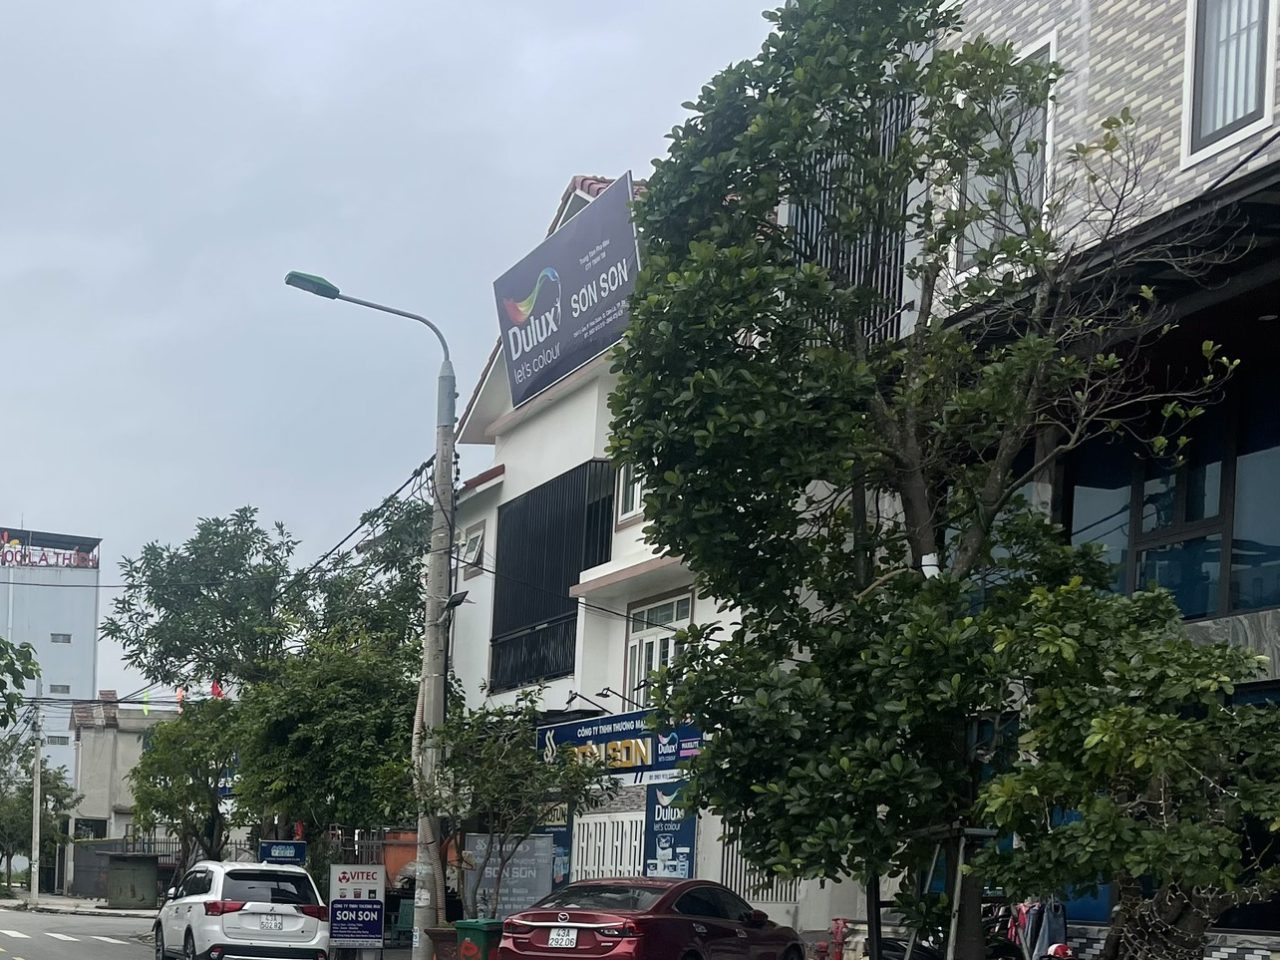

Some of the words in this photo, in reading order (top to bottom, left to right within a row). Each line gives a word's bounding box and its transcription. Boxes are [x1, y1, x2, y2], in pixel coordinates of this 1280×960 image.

[600, 258, 628, 298] SON
[508, 307, 558, 361] Dulux
[514, 362, 532, 385] let's
[532, 342, 561, 373] colour
[592, 726, 599, 737] TY
[606, 738, 652, 769] SON
[658, 743, 676, 755] Dulux
[655, 804, 680, 821] Dulux
[664, 822, 681, 831] colour
[350, 872, 377, 880] VITEC
[358, 911, 378, 921] SON
[556, 929, 570, 937] 43A
[549, 938, 575, 946] 292.06
